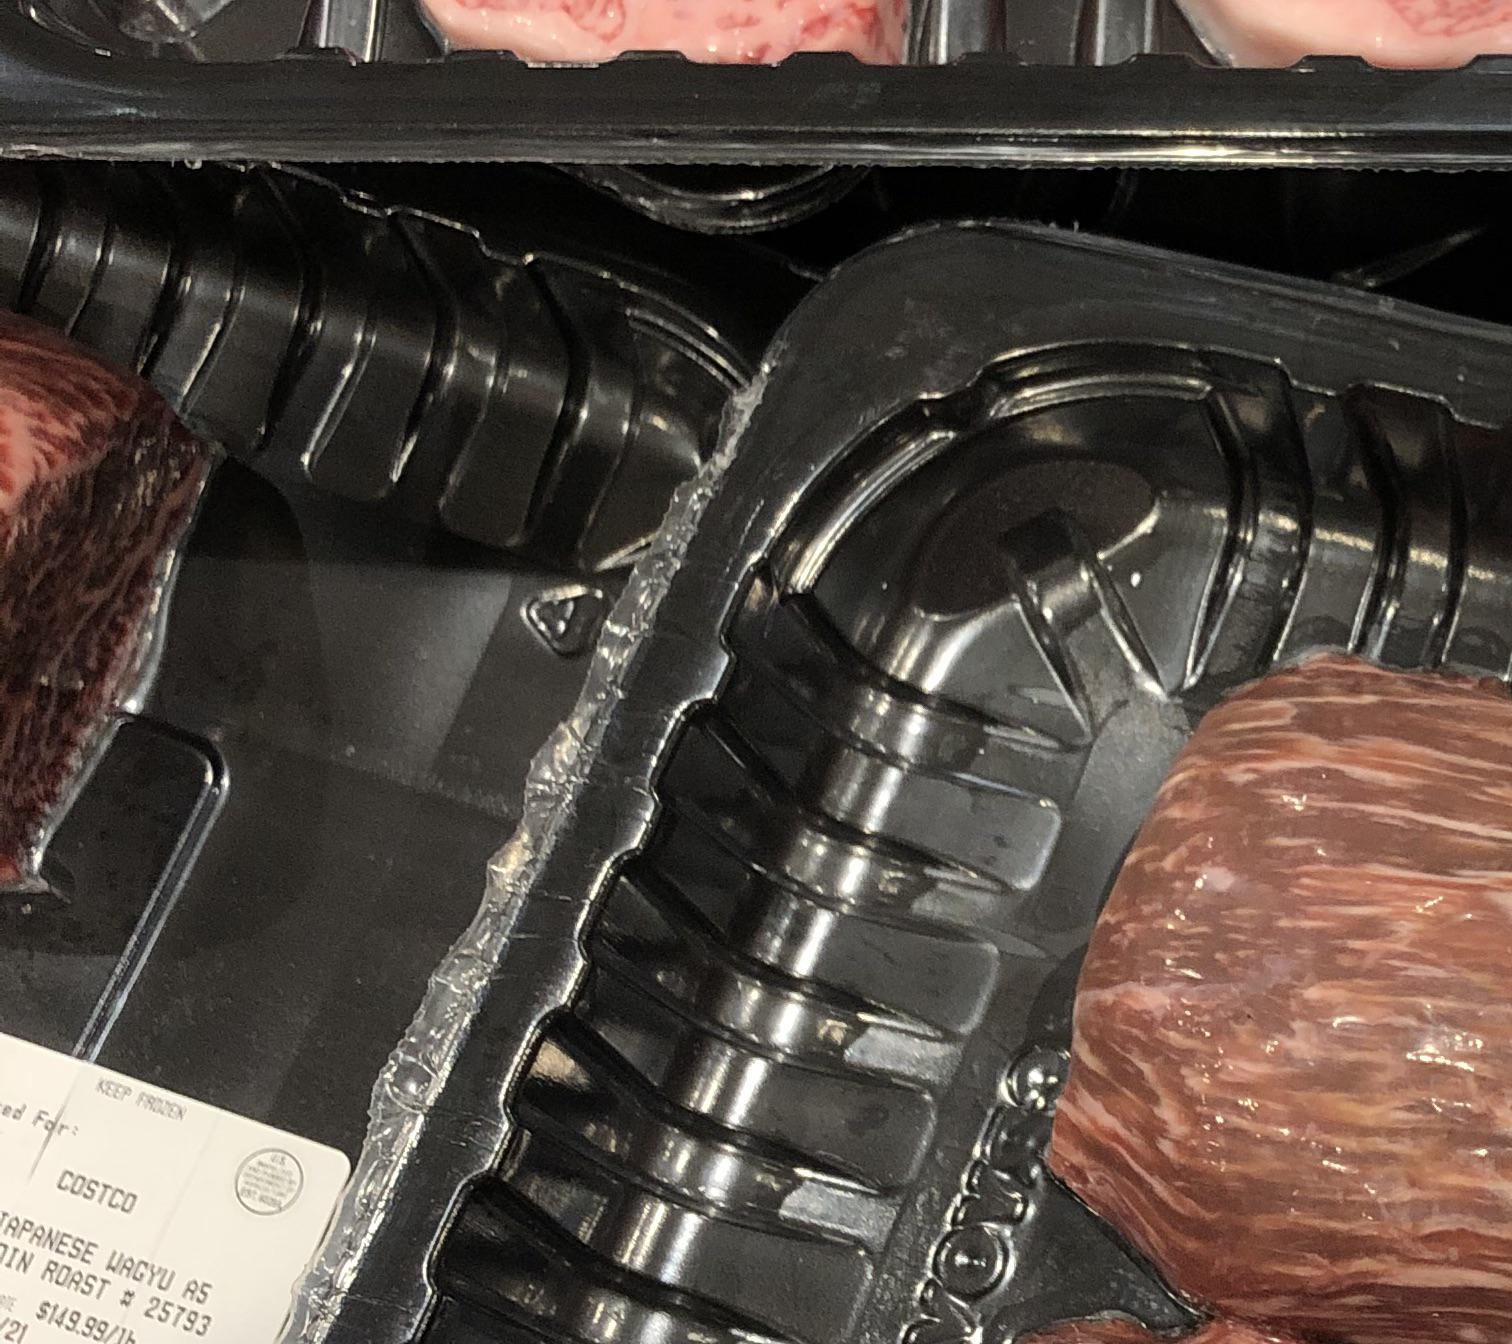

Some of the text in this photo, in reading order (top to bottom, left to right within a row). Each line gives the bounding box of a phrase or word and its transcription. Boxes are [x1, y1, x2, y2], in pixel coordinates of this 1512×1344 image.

[56, 1169, 138, 1214] COSTCO
[40, 1259, 112, 1300] ROAST
[119, 1289, 136, 1308] #
[143, 1296, 212, 1337] 25793
[105, 1250, 176, 1292] WAGYU
[181, 1279, 213, 1305] A5
